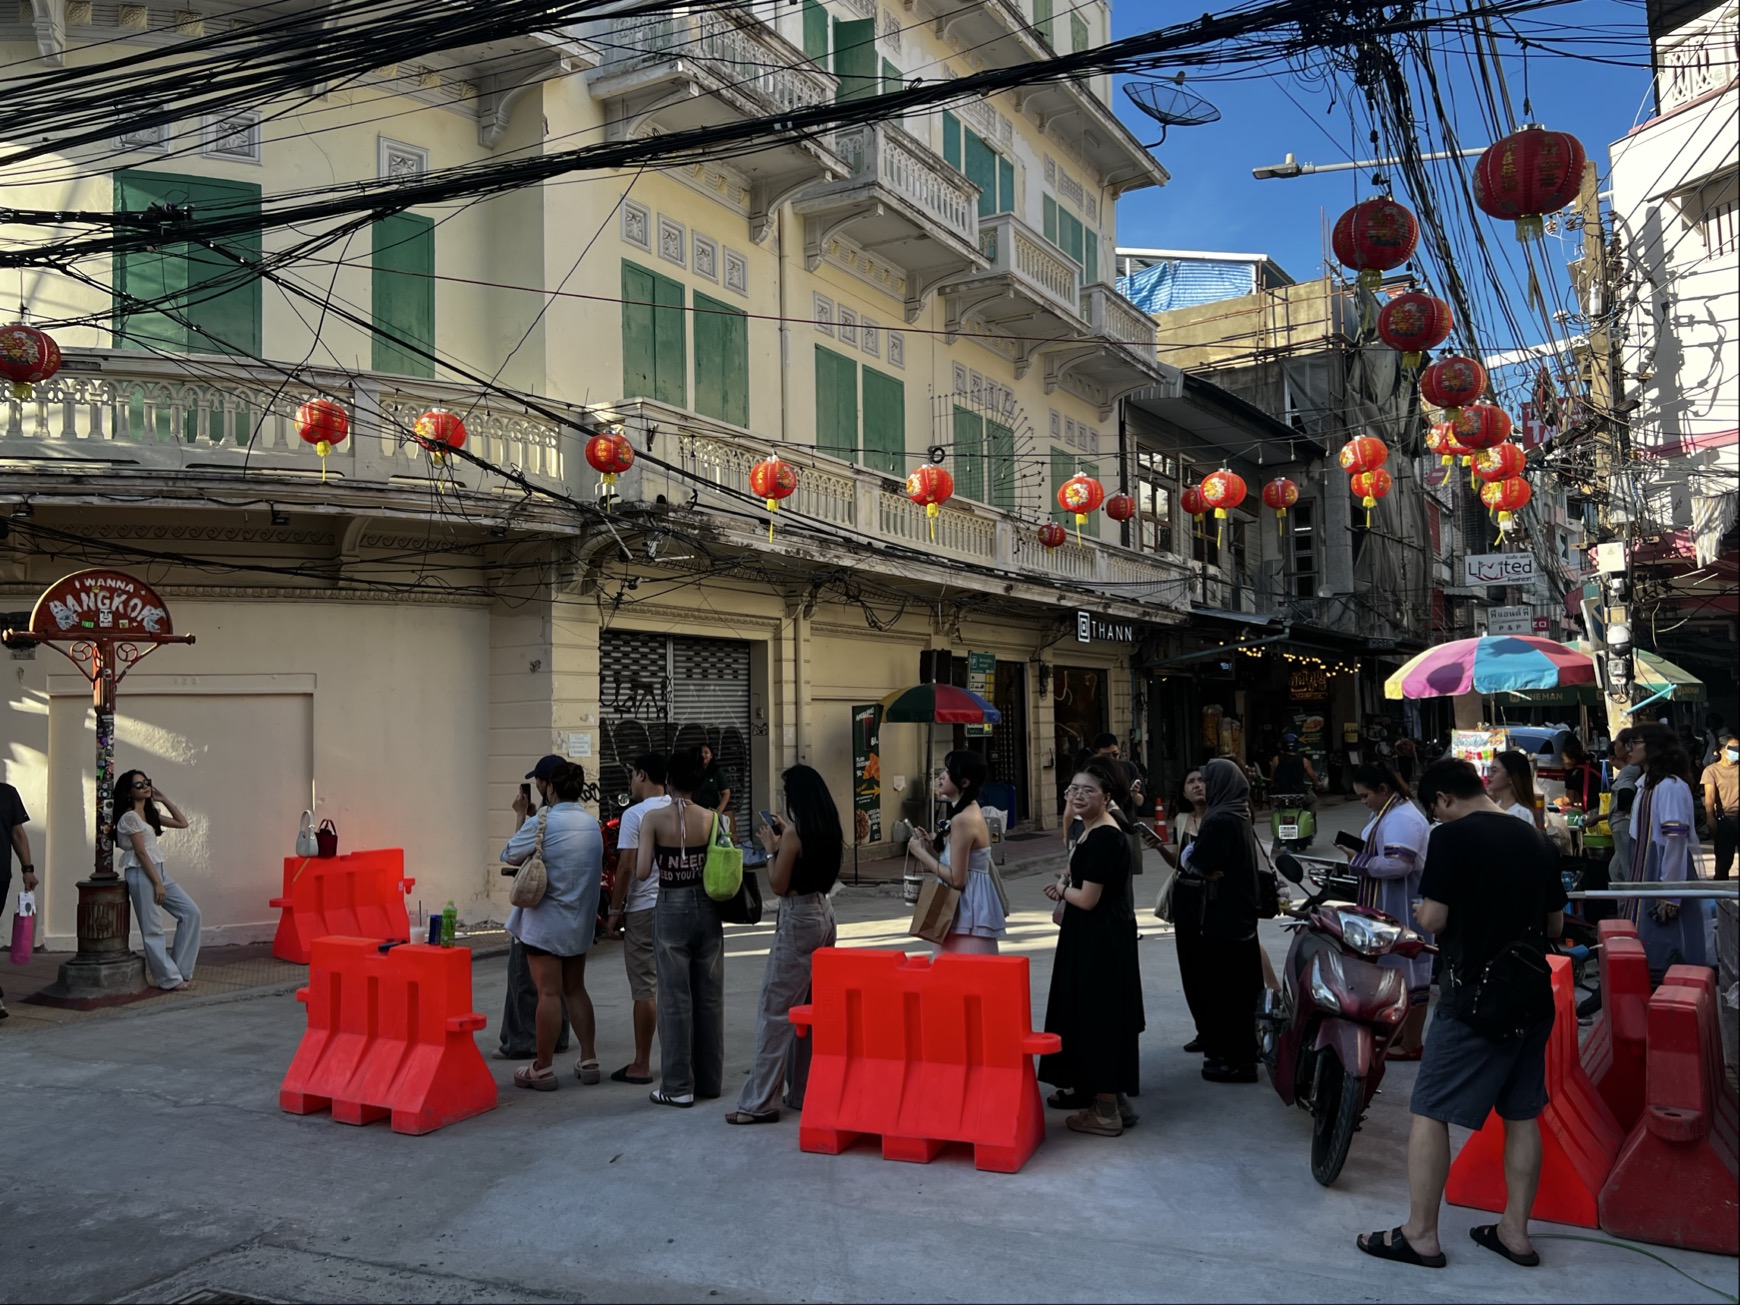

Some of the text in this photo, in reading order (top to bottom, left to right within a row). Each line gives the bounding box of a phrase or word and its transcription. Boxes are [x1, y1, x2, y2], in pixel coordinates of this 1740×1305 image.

[74, 577, 134, 593] I WANNA
[1091, 619, 1133, 643] THANN
[668, 852, 706, 869] NEED
